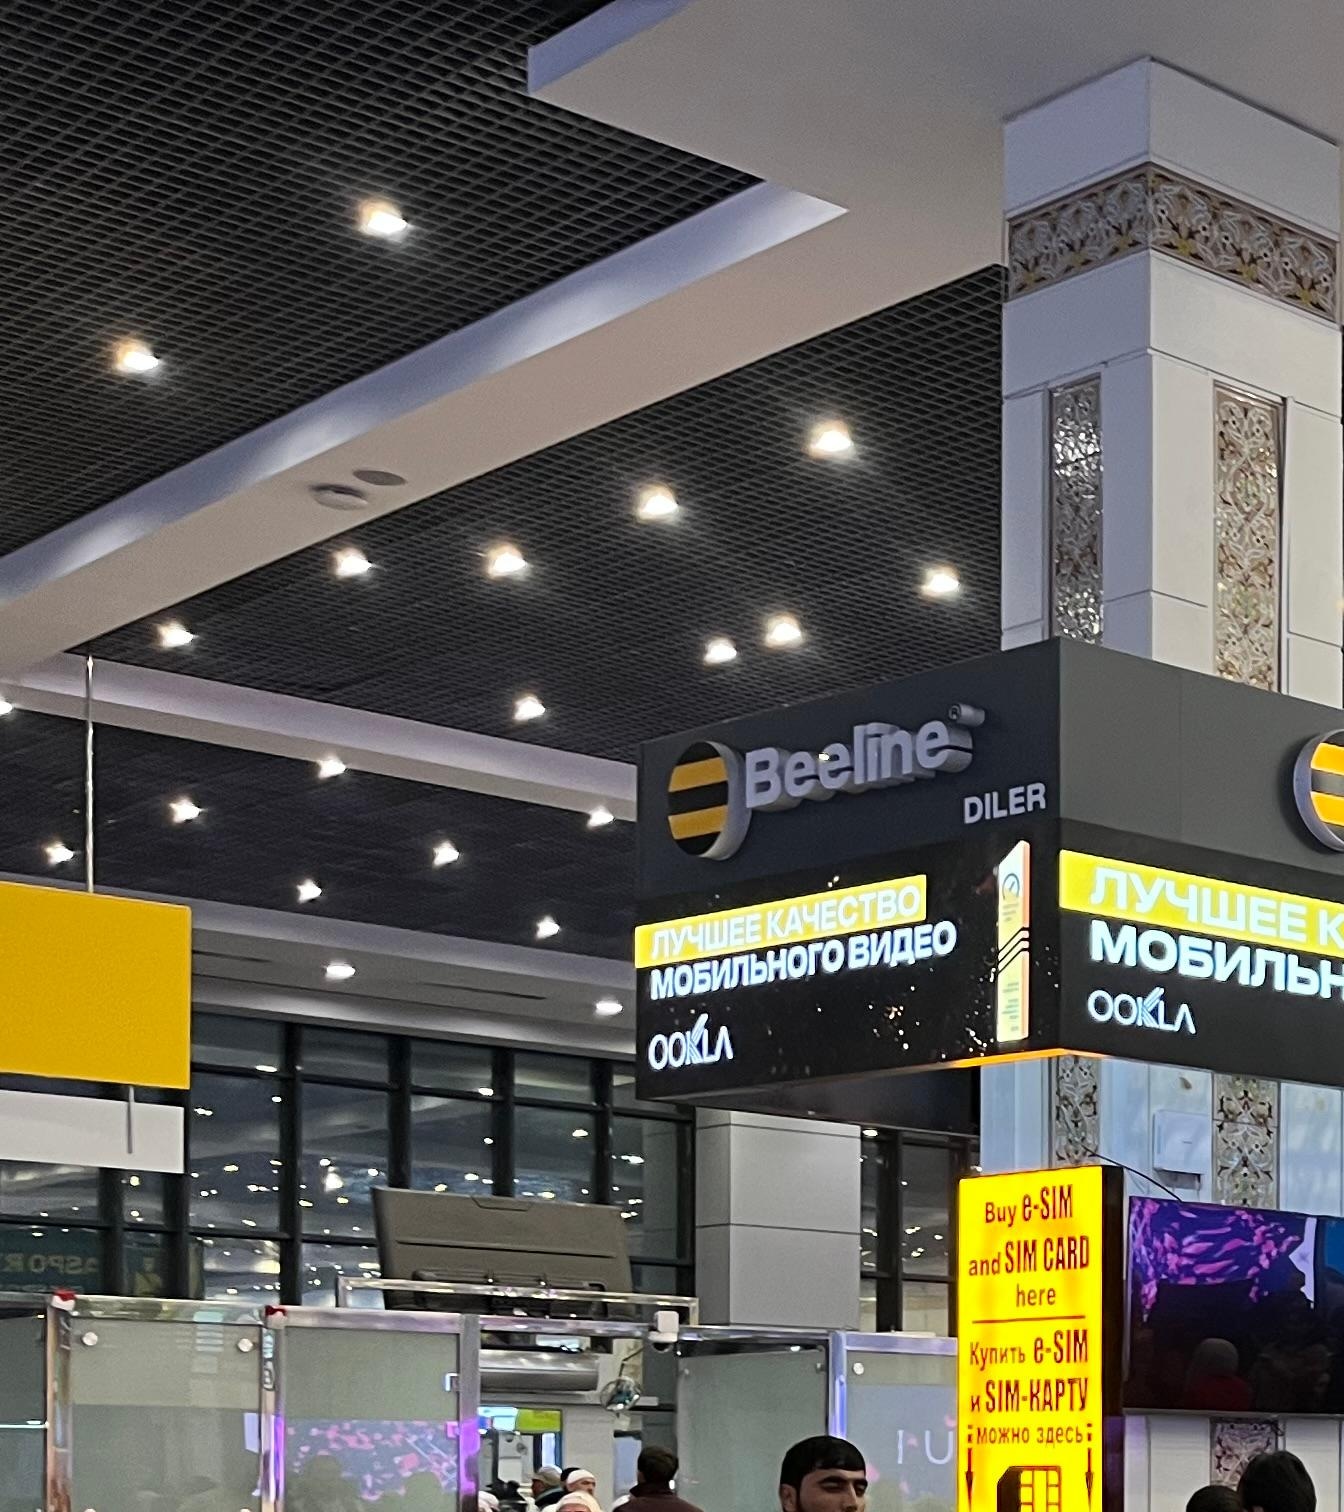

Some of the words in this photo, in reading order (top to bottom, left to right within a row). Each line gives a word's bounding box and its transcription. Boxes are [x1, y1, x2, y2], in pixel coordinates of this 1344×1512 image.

[964, 782, 1047, 826] DILER
[651, 912, 761, 961] ЛУЧШЕЕ
[766, 883, 921, 936] КАЧЕСТВО
[1090, 867, 1308, 943] ЛУЧШЕЕ
[650, 940, 846, 1000] МОБИЛЬНОГО
[848, 920, 957, 971] ВИДЕО
[1087, 986, 1197, 1034] OOKLA
[648, 1014, 734, 1071] OOKLA
[984, 1201, 1017, 1228] Buy
[1021, 1184, 1074, 1221] e-SIM
[968, 1252, 1001, 1277] and
[1004, 1239, 1040, 1274] SIM
[1043, 1235, 1090, 1271] CARD
[1015, 1282, 1056, 1308] here
[969, 1341, 1026, 1369] Купить
[1033, 1329, 1089, 1364] e-SIM
[970, 1394, 982, 1413] и
[985, 1376, 1089, 1413] SIM-КАРТУ
[975, 1426, 1031, 1446] можно
[1035, 1424, 1084, 1445] здесь
